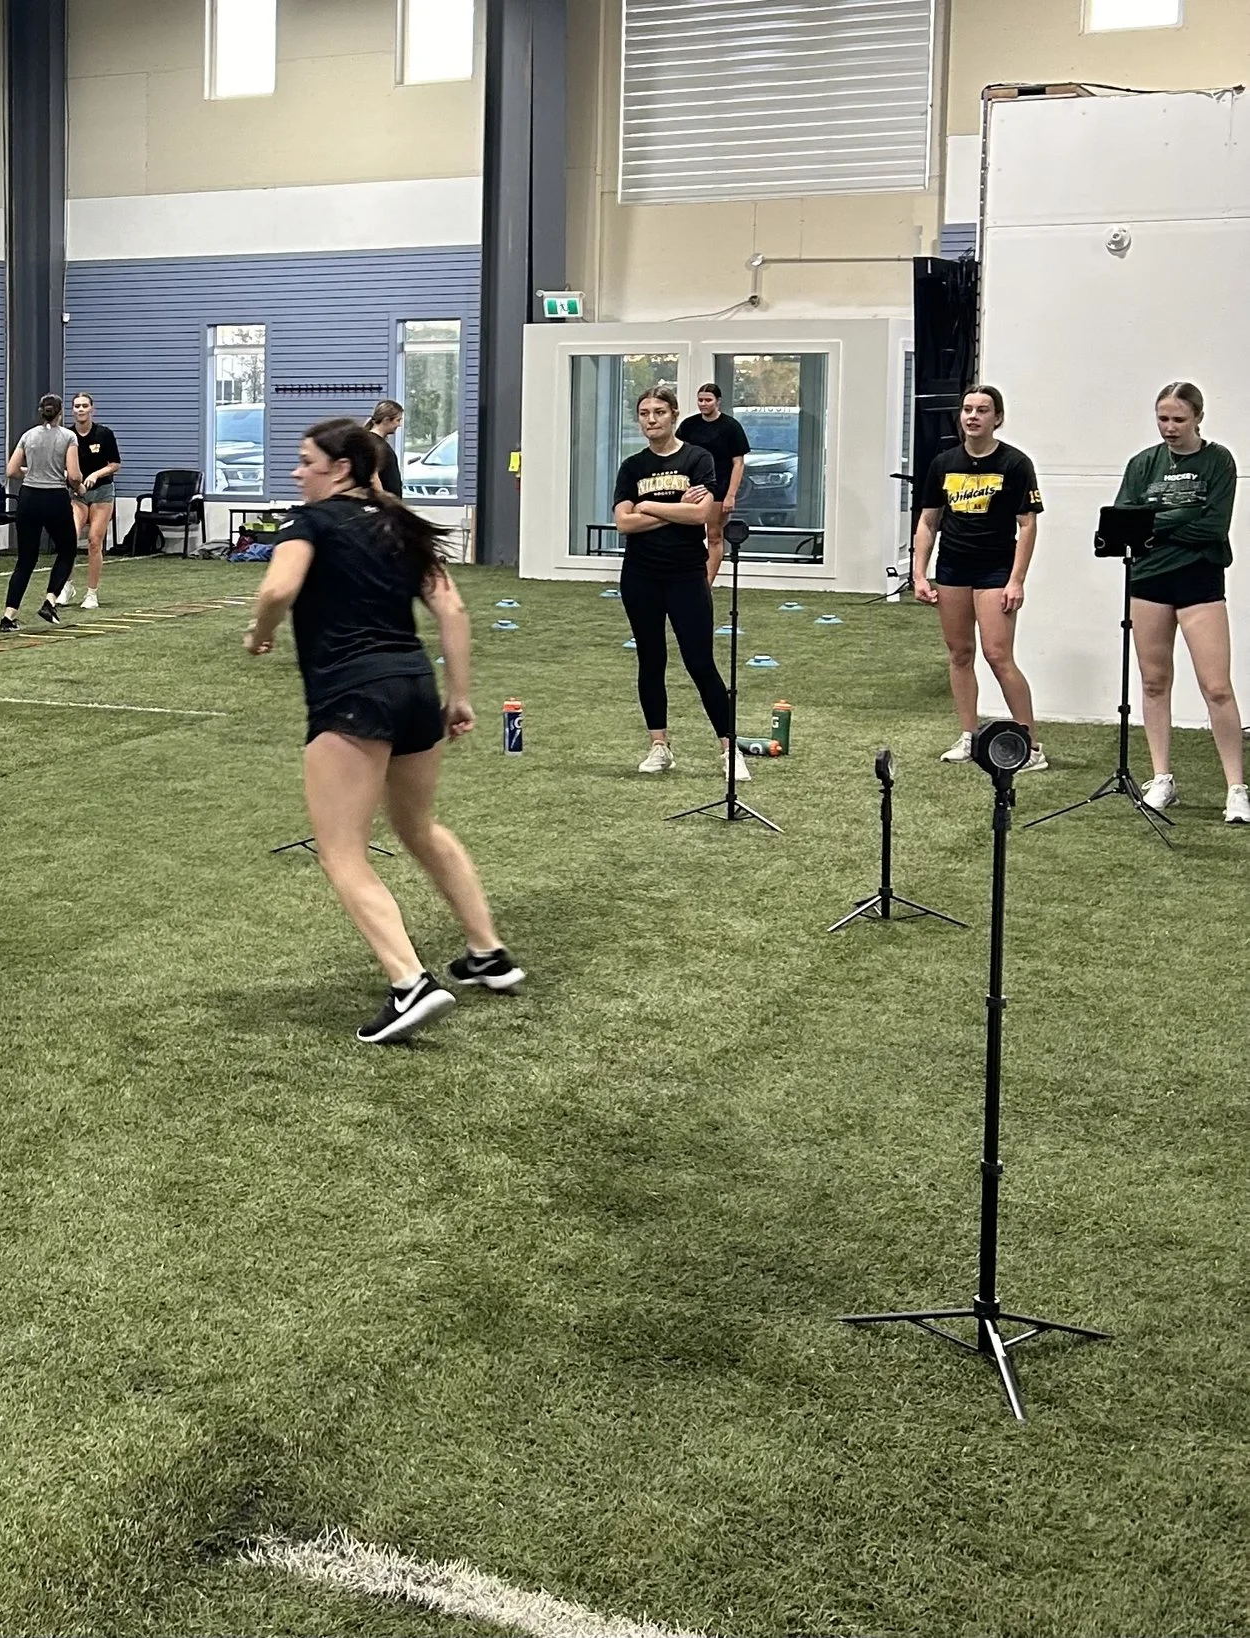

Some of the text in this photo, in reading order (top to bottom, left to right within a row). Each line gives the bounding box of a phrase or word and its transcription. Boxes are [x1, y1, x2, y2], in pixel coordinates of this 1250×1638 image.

[1163, 473, 1198, 481] HOCKEY
[636, 475, 691, 497] WILDCATS
[948, 485, 996, 504] Wildcats
[1028, 489, 1041, 504] 19
[771, 716, 780, 729] G
